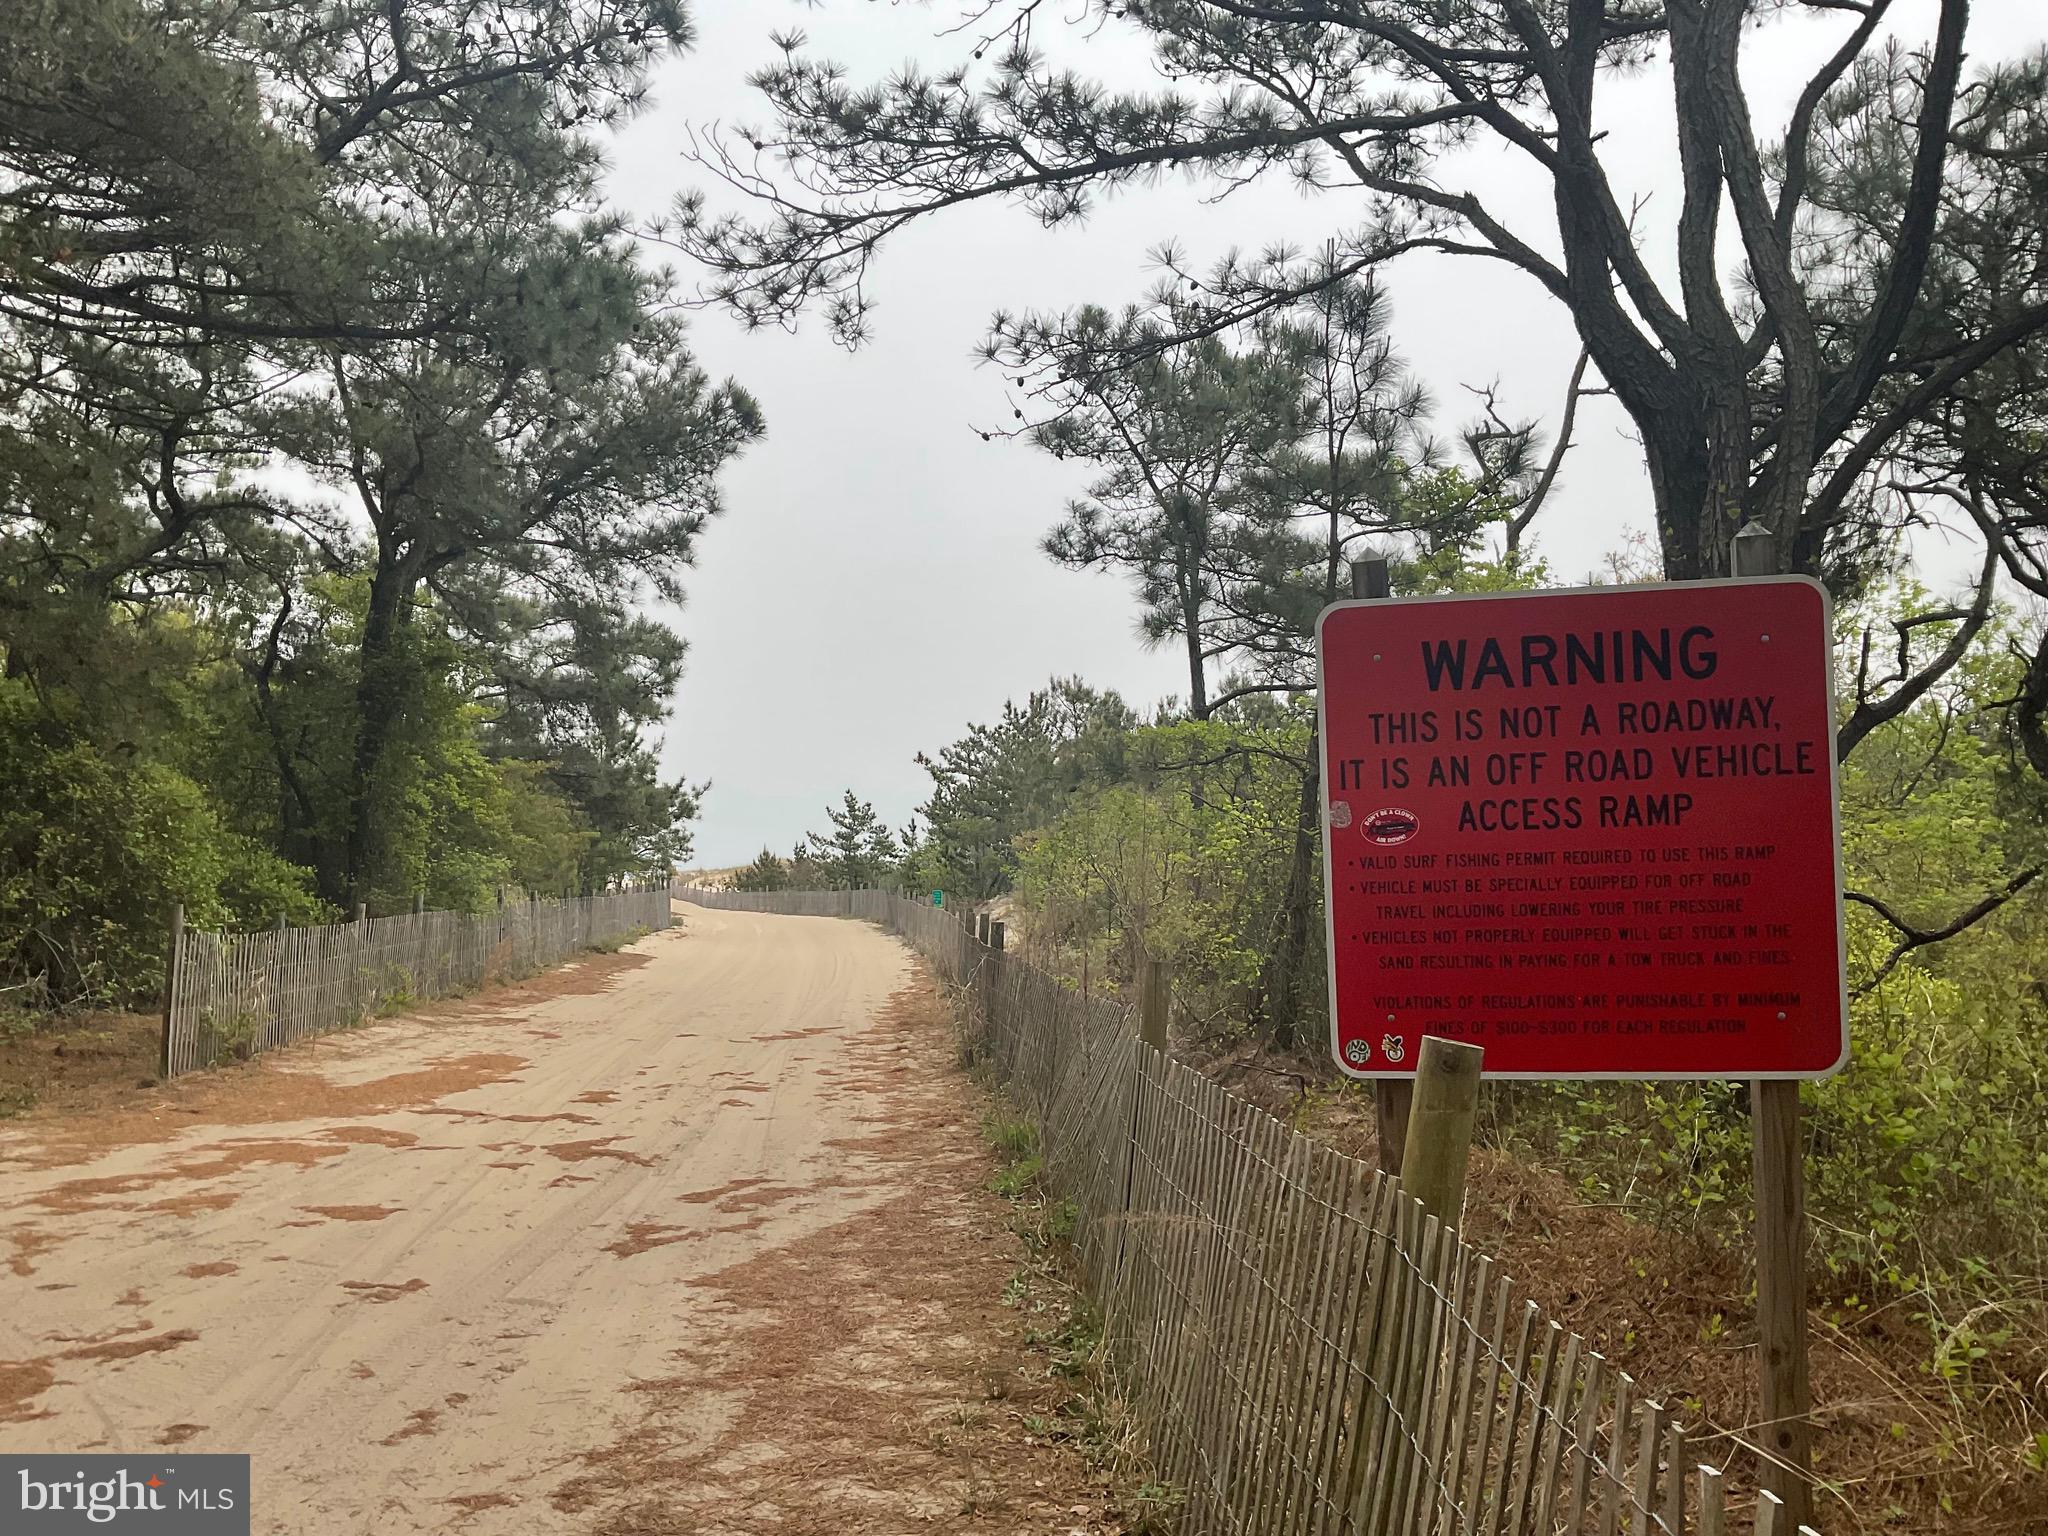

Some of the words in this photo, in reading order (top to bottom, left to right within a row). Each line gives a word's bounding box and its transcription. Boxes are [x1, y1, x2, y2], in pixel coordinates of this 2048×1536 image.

[1421, 626, 1718, 692] WARNING
[1368, 711, 1438, 745] THIS
[1455, 709, 1483, 741] IS
[1500, 705, 1561, 739] NOT
[1580, 704, 1600, 736] A
[1618, 696, 1781, 734] ROADWAY,
[1340, 759, 1364, 790] IT
[1381, 757, 1409, 789] IS
[1427, 755, 1470, 787] AN
[1486, 752, 1547, 785] OFF
[1565, 748, 1653, 784] ROAD
[1671, 741, 1815, 778] VEHICLE
[1394, 810, 1415, 822] CLOWN
[1458, 797, 1583, 832] ACCESS
[1599, 793, 1693, 828] RAMP
[1360, 856, 1397, 869] VALID
[1403, 854, 1438, 868] SURF
[1446, 853, 1500, 867] FISHING
[1506, 851, 1556, 866] PERMIT
[1563, 849, 1632, 864] REQUIRED
[1641, 849, 1656, 862] TO
[1662, 848, 1690, 861] USE
[1697, 847, 1728, 860] THIS
[1735, 845, 1775, 859] RAMP
[1360, 880, 1416, 894] VEHICLE
[1423, 879, 1458, 893] MUST
[1465, 879, 1482, 892] BE
[1489, 877, 1562, 891] SPECIALLY
[1570, 875, 1638, 890] EQUIPPED
[1645, 874, 1672, 888] FOR
[1679, 873, 1705, 887] OFF
[1712, 872, 1751, 886] ROAD
[1376, 905, 1426, 919] TRAVEL
[1432, 904, 1505, 918] INCLUDING
[1511, 903, 1581, 916] LOWERING
[1589, 901, 1625, 915] YOUR
[1632, 900, 1662, 914] TIRE
[1669, 898, 1743, 913] PRESSURE
[1362, 931, 1427, 944] VEHICLES
[1433, 930, 1458, 943] NOT
[1465, 929, 1535, 943] PROPERLY
[1543, 927, 1612, 942] EQUIPPED
[1618, 926, 1651, 940] WILL
[1658, 926, 1684, 940] GET
[1691, 925, 1736, 939] STUCK
[1743, 924, 1758, 937] IN
[1766, 923, 1792, 938] THE
[1378, 956, 1414, 969] SAND
[1420, 955, 1493, 969] RESULTING
[1500, 955, 1513, 968] IN
[1519, 954, 1567, 967] PAYING
[1573, 953, 1601, 967] FOR
[1608, 953, 1616, 966] A
[1625, 953, 1651, 966] TOW
[1661, 952, 1705, 966] TRUCK
[1712, 951, 1743, 965] AND
[1373, 995, 1451, 1009] VIOLATIONS
[1457, 995, 1474, 1008] OF
[1482, 994, 1576, 1008] REGULATIONS
[1582, 994, 1608, 1007] ARE
[1616, 992, 1706, 1007] PUNISHABLE
[1712, 992, 1731, 1006] BY
[1737, 991, 1801, 1006] MINIMUM
[1424, 1020, 1465, 1034] FINES
[1471, 1020, 1488, 1034] OF
[1583, 1019, 1610, 1033] FOR
[1616, 1019, 1653, 1033] EACH
[1659, 1018, 1746, 1033] REGULATION
